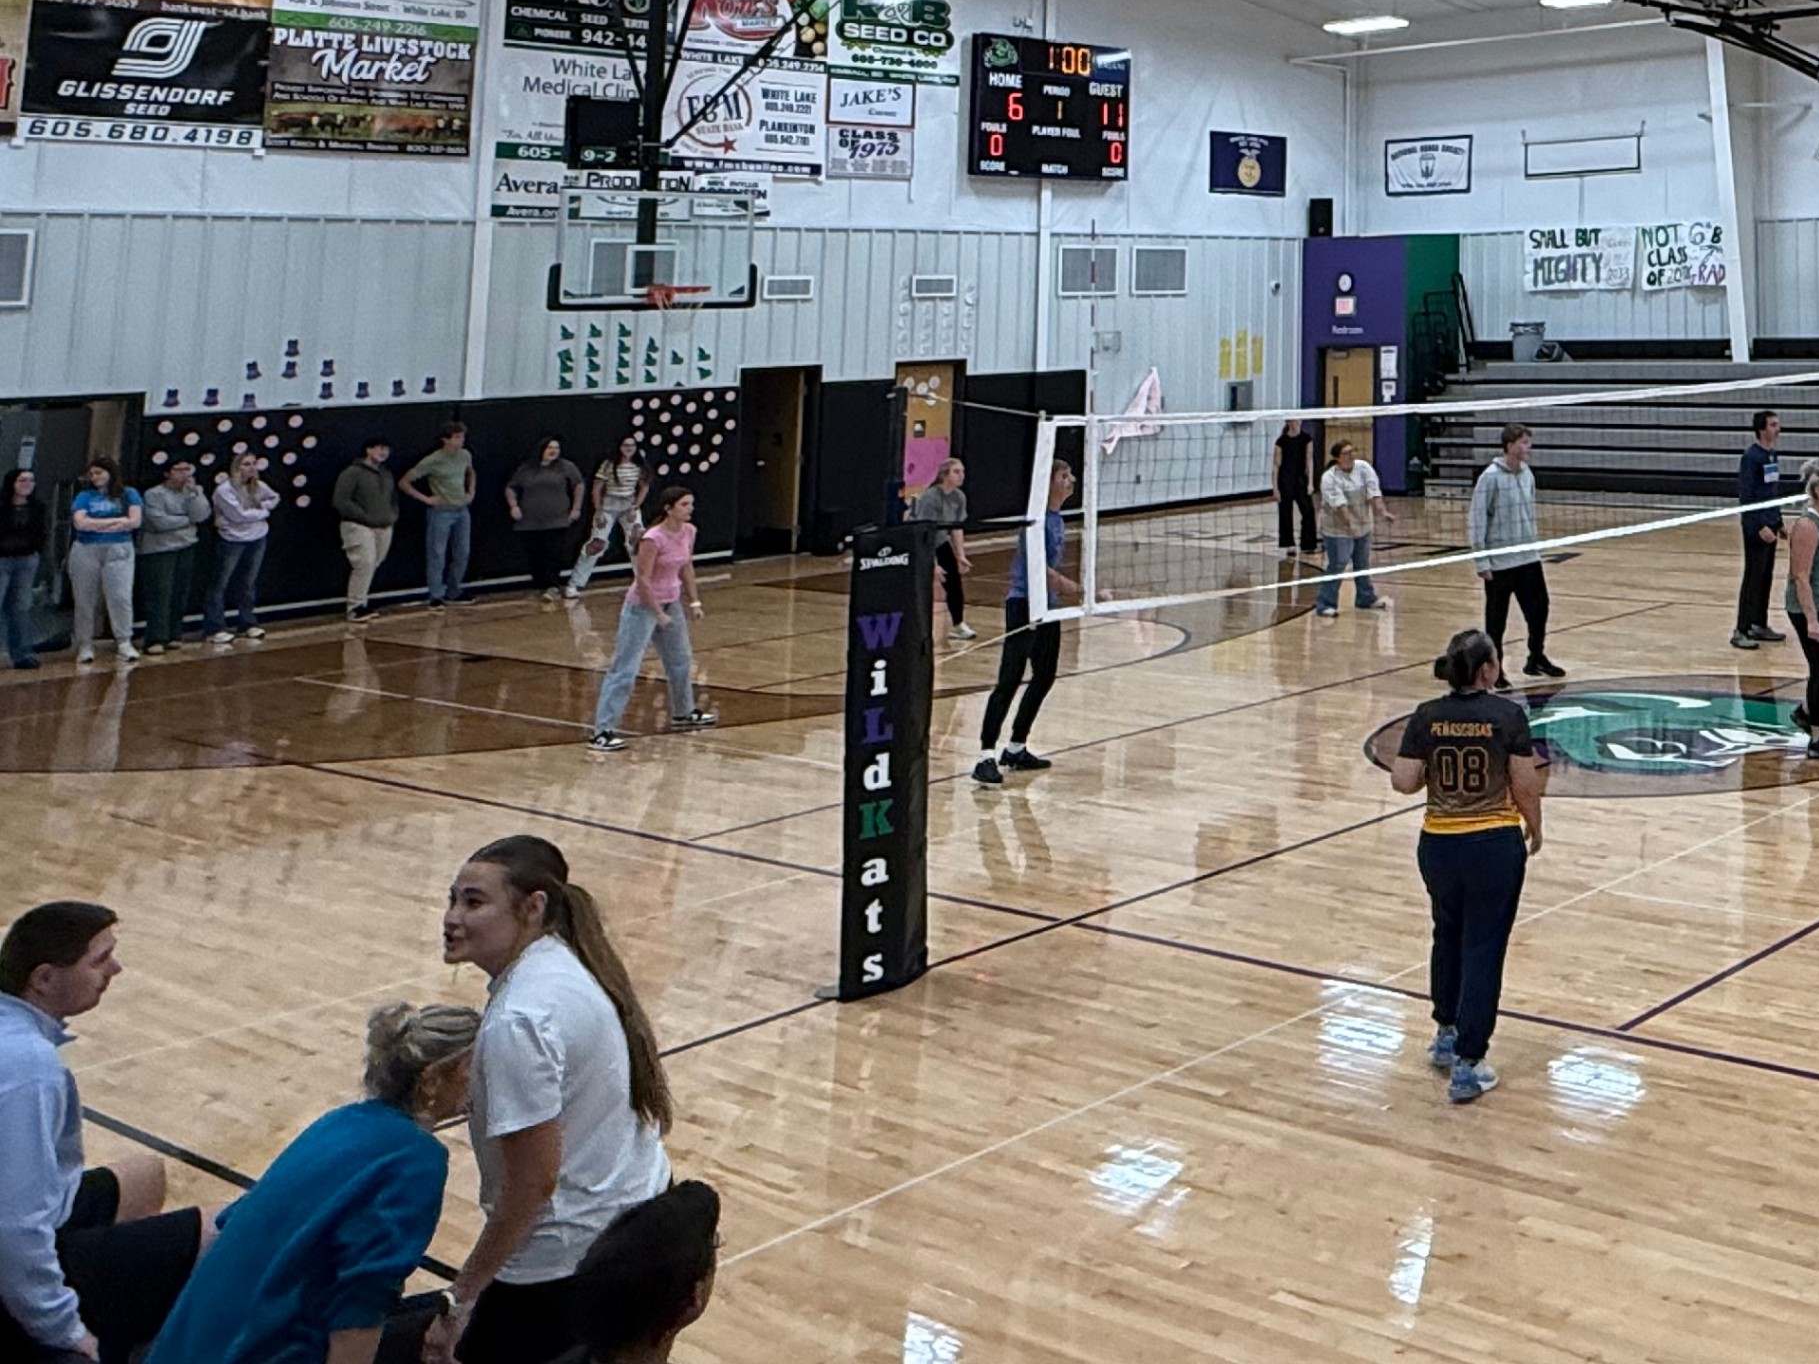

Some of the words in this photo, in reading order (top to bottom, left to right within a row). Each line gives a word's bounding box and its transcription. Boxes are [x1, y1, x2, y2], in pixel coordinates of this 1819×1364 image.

[510, 6, 568, 21] CHEMICAL
[580, 13, 608, 25] SEED
[273, 27, 356, 51] PLATTE
[362, 35, 471, 60] LIVESTOCK
[581, 29, 648, 49] 942-14
[843, 22, 908, 43] SEED
[311, 48, 437, 85] Market
[552, 58, 608, 79] White
[717, 52, 745, 65] LAKE
[1048, 45, 1091, 77] 1:00
[57, 80, 235, 106] GLISSENDORF
[522, 76, 599, 99] Medical
[602, 82, 637, 99] Clin
[761, 87, 790, 102] WHITE
[794, 90, 817, 104] LAKE
[989, 72, 1023, 89] HOME
[1089, 82, 1124, 98] GUEST
[840, 86, 902, 108] JAKE'S
[1007, 92, 1024, 121] 6
[124, 102, 171, 116] SEED
[28, 119, 254, 145] 605.680.4198
[838, 129, 900, 143] CLASS
[838, 138, 860, 152] OF
[990, 134, 1003, 157] 0
[1110, 142, 1123, 164] 0
[495, 172, 559, 194] Avera
[1574, 227, 1602, 248] BUT
[1647, 245, 1688, 268] CLASS
[1532, 252, 1603, 288] MIGHTY
[1646, 268, 1666, 286] OF
[1434, 746, 1490, 794] 08
